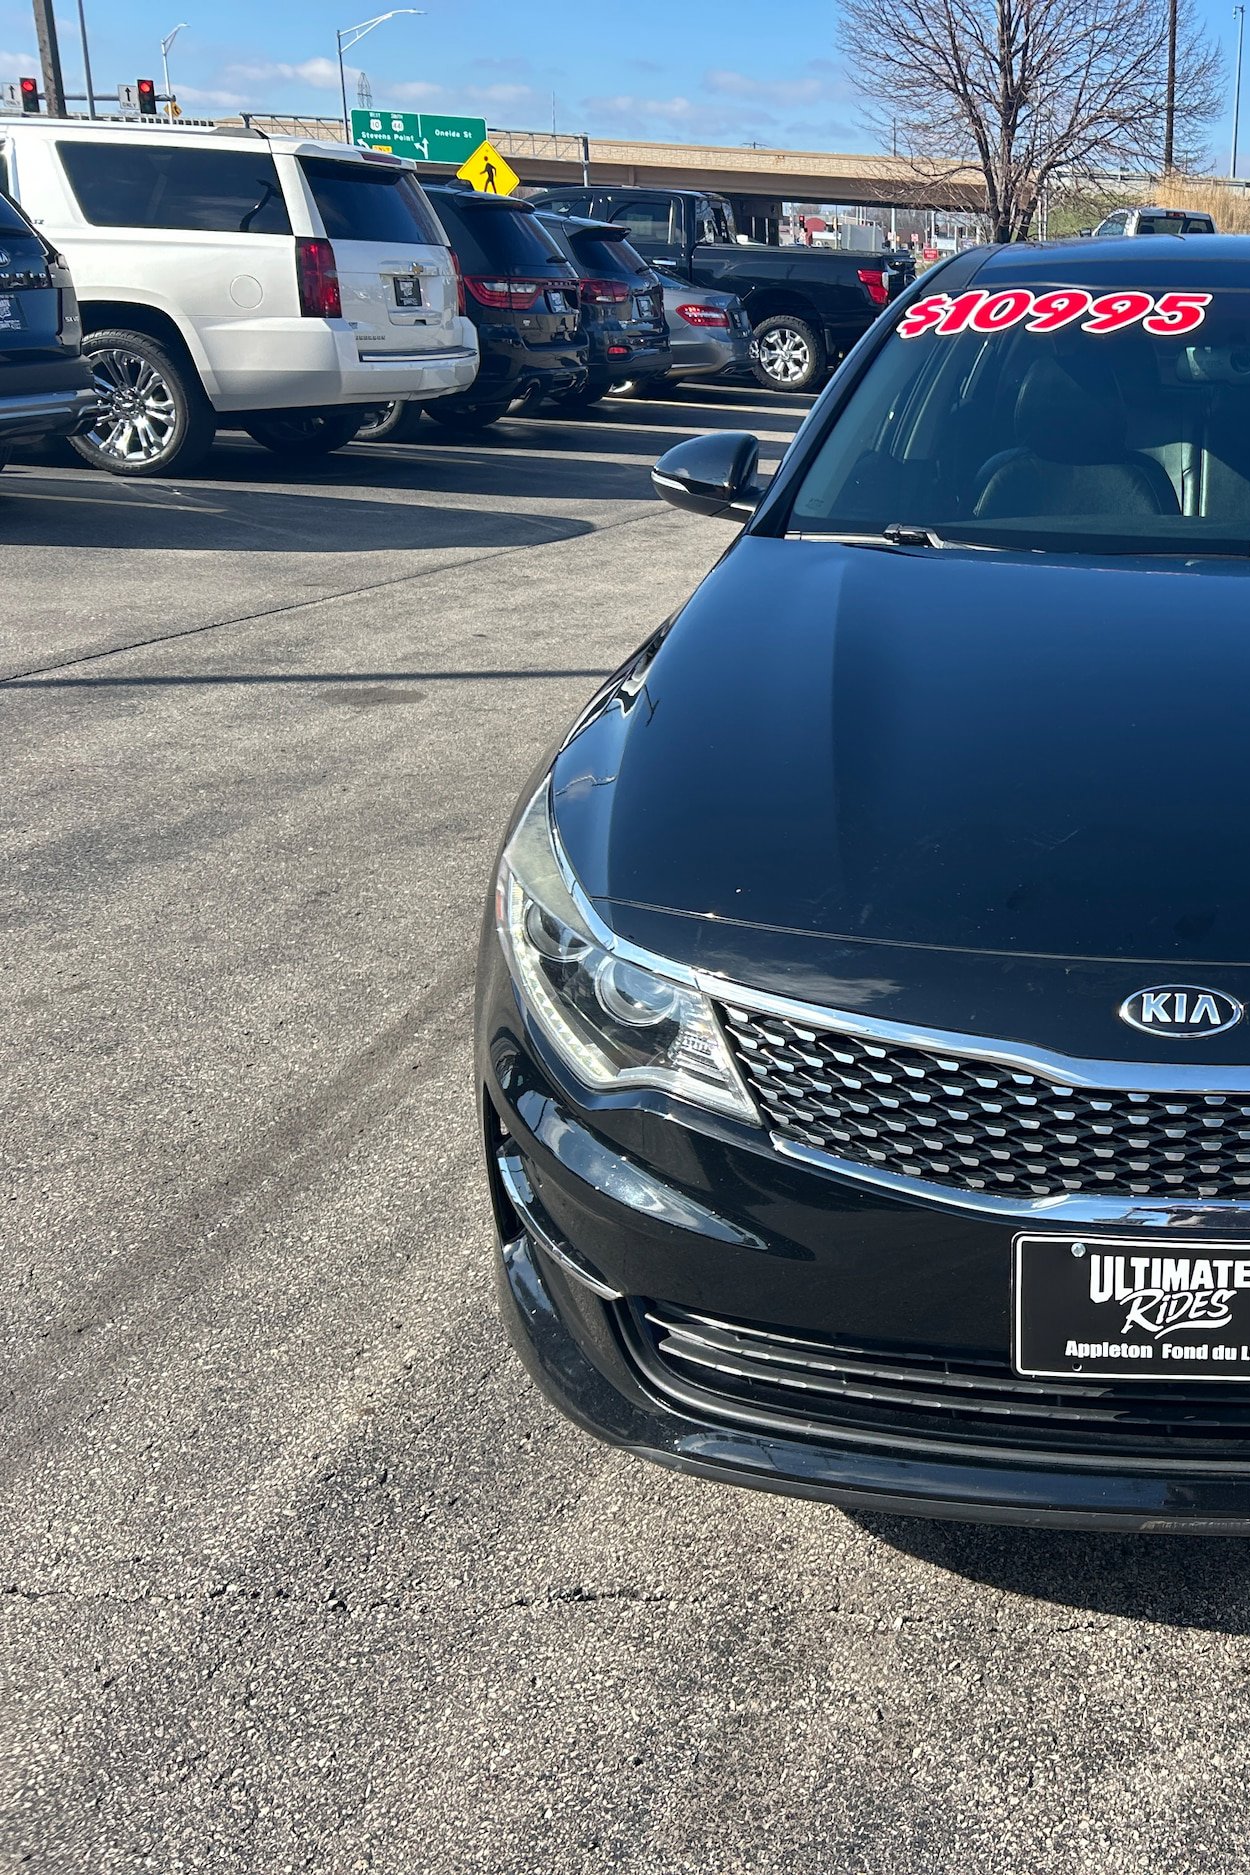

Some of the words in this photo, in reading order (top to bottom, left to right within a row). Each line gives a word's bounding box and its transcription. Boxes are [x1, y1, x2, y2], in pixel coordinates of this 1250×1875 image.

[361, 131, 391, 140] Stevens
[393, 133, 414, 142] Point
[434, 129, 460, 138] Oneida
[463, 131, 472, 139] St
[896, 289, 1214, 338] $10995
[1141, 992, 1221, 1025] KIA
[1065, 1340, 1153, 1359] Appleton
[1161, 1343, 1209, 1361] Fond
[1212, 1344, 1238, 1361] du
